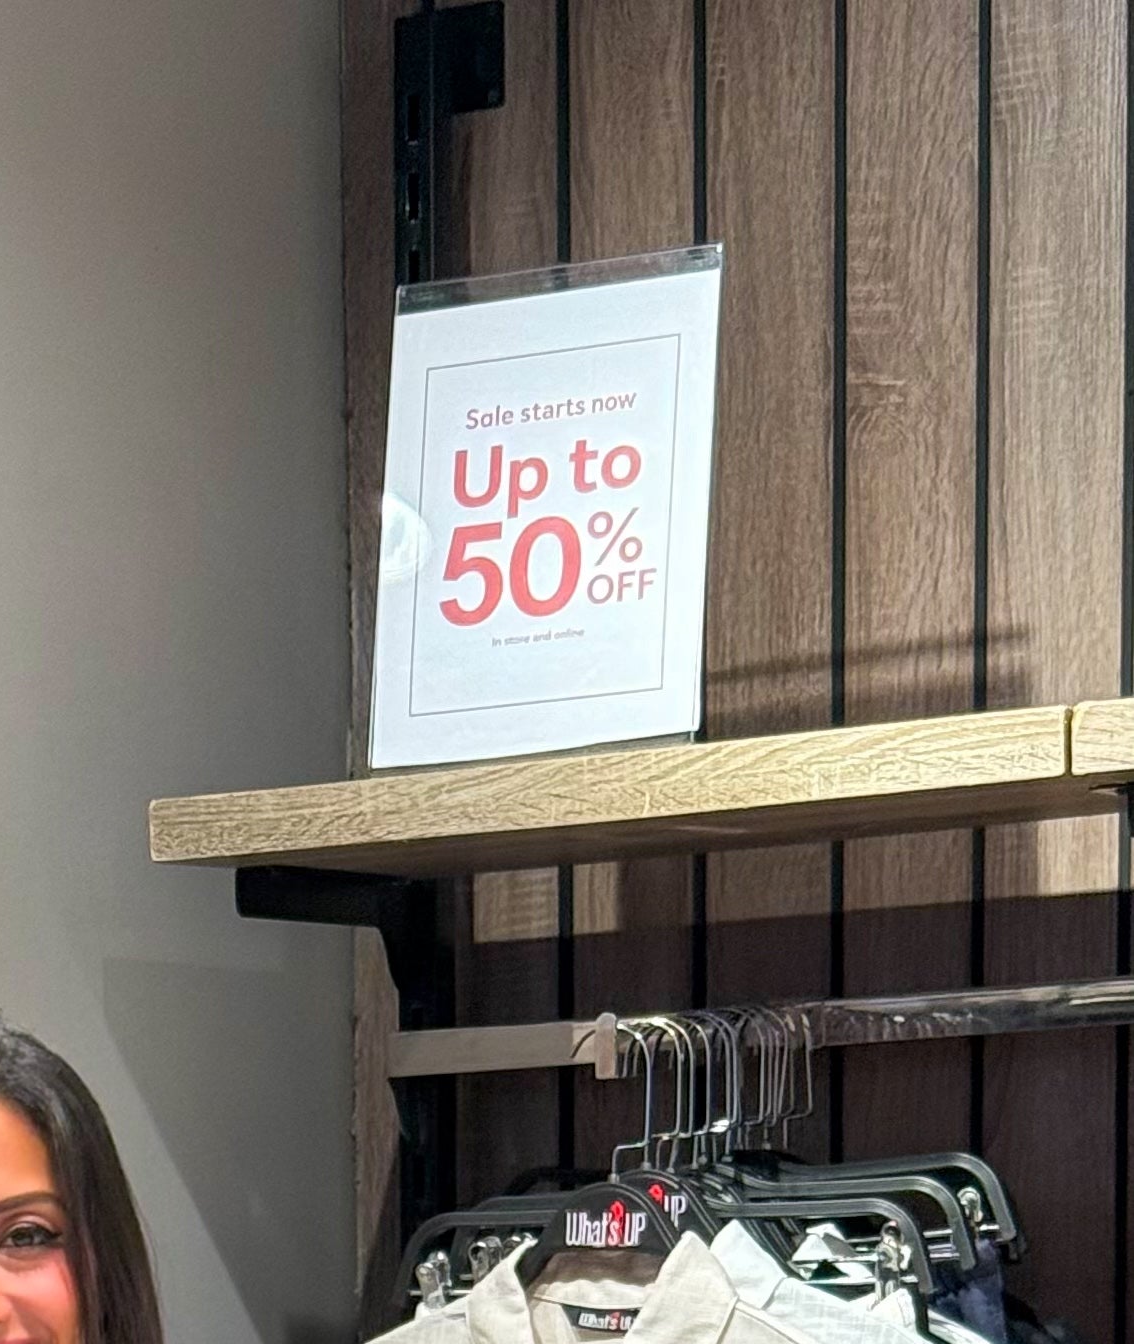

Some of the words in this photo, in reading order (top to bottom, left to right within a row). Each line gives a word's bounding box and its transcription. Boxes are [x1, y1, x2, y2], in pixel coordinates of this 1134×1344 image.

[466, 405, 514, 429] Sale
[520, 399, 585, 423] starts
[591, 392, 637, 413] now
[453, 444, 549, 519] Up
[568, 439, 642, 494] to
[586, 567, 657, 605] OFF
[566, 1211, 620, 1246] What's
[623, 1212, 647, 1247] UP
